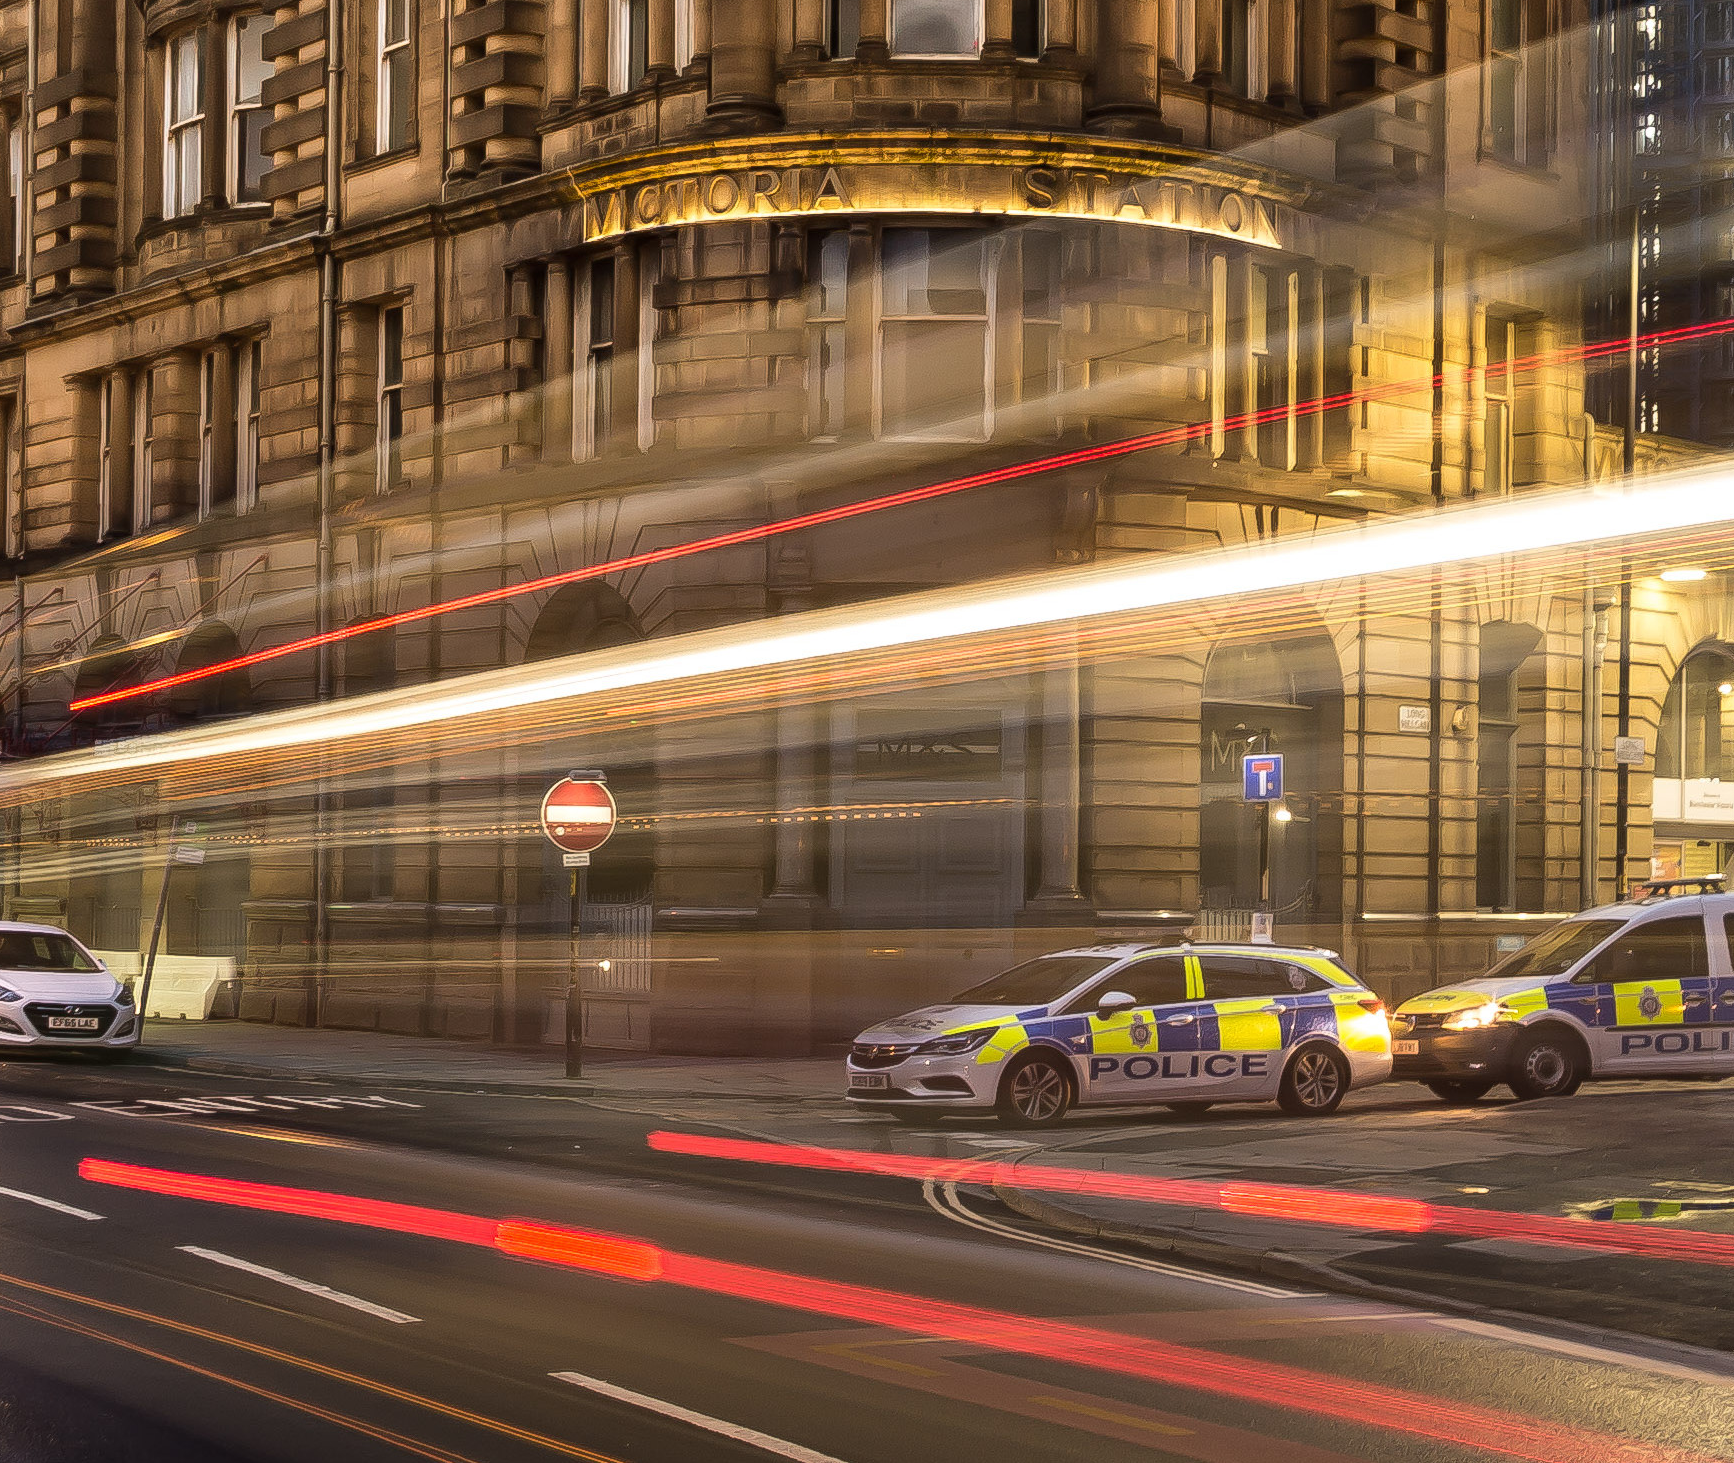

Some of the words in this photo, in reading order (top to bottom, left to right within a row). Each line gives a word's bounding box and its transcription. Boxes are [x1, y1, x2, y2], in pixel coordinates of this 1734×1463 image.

[589, 164, 853, 238] VICTORIA
[1016, 166, 1281, 249] STATION
[1089, 1053, 1269, 1082] POLICE
[66, 1094, 427, 1118] ENTRY
